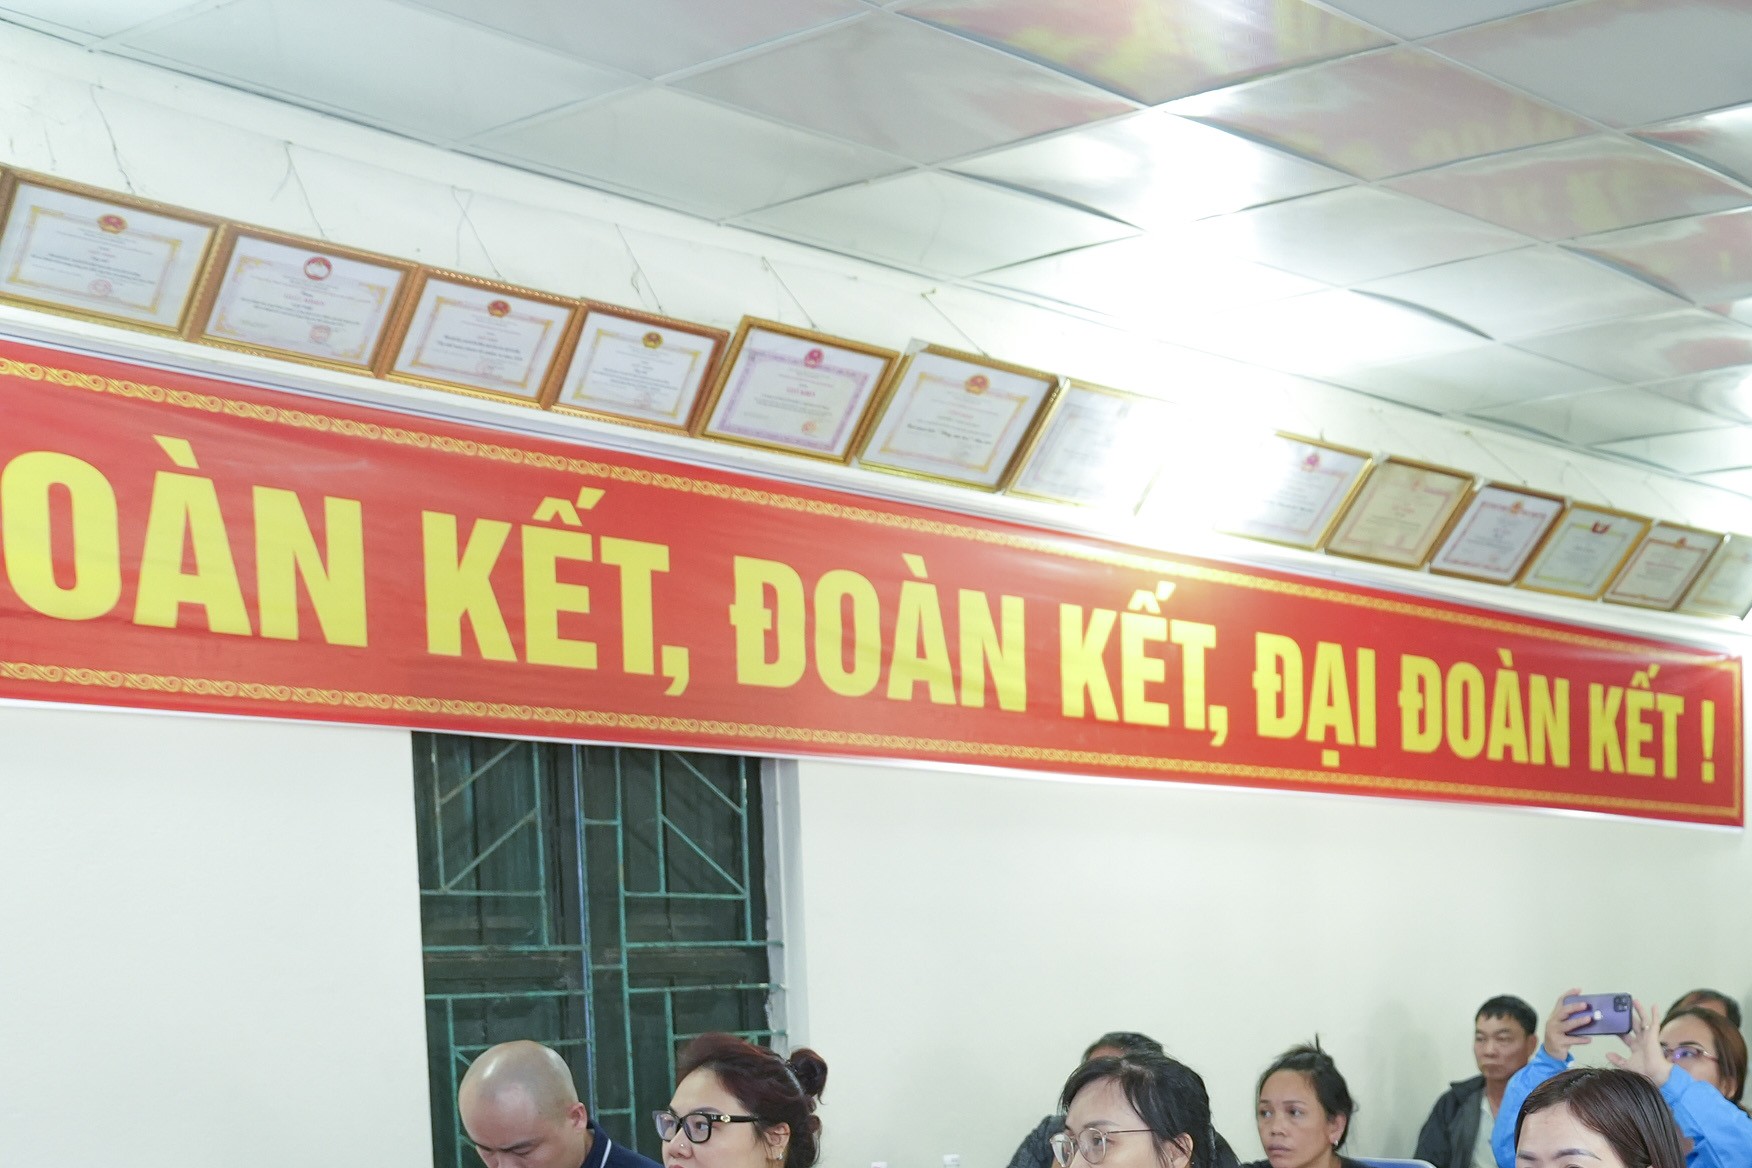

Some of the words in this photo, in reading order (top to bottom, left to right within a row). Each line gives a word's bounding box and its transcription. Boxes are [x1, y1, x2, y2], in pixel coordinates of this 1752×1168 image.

[1, 437, 367, 648] OÀN
[423, 489, 689, 695] KẾT,
[729, 554, 1027, 711] ĐOÀN
[1060, 581, 1228, 746] KẾT,
[1253, 632, 1377, 767] ĐẠI
[1398, 648, 1570, 768] ĐOÀN
[1589, 664, 1684, 779] KẾT
[1702, 700, 1716, 783] !
